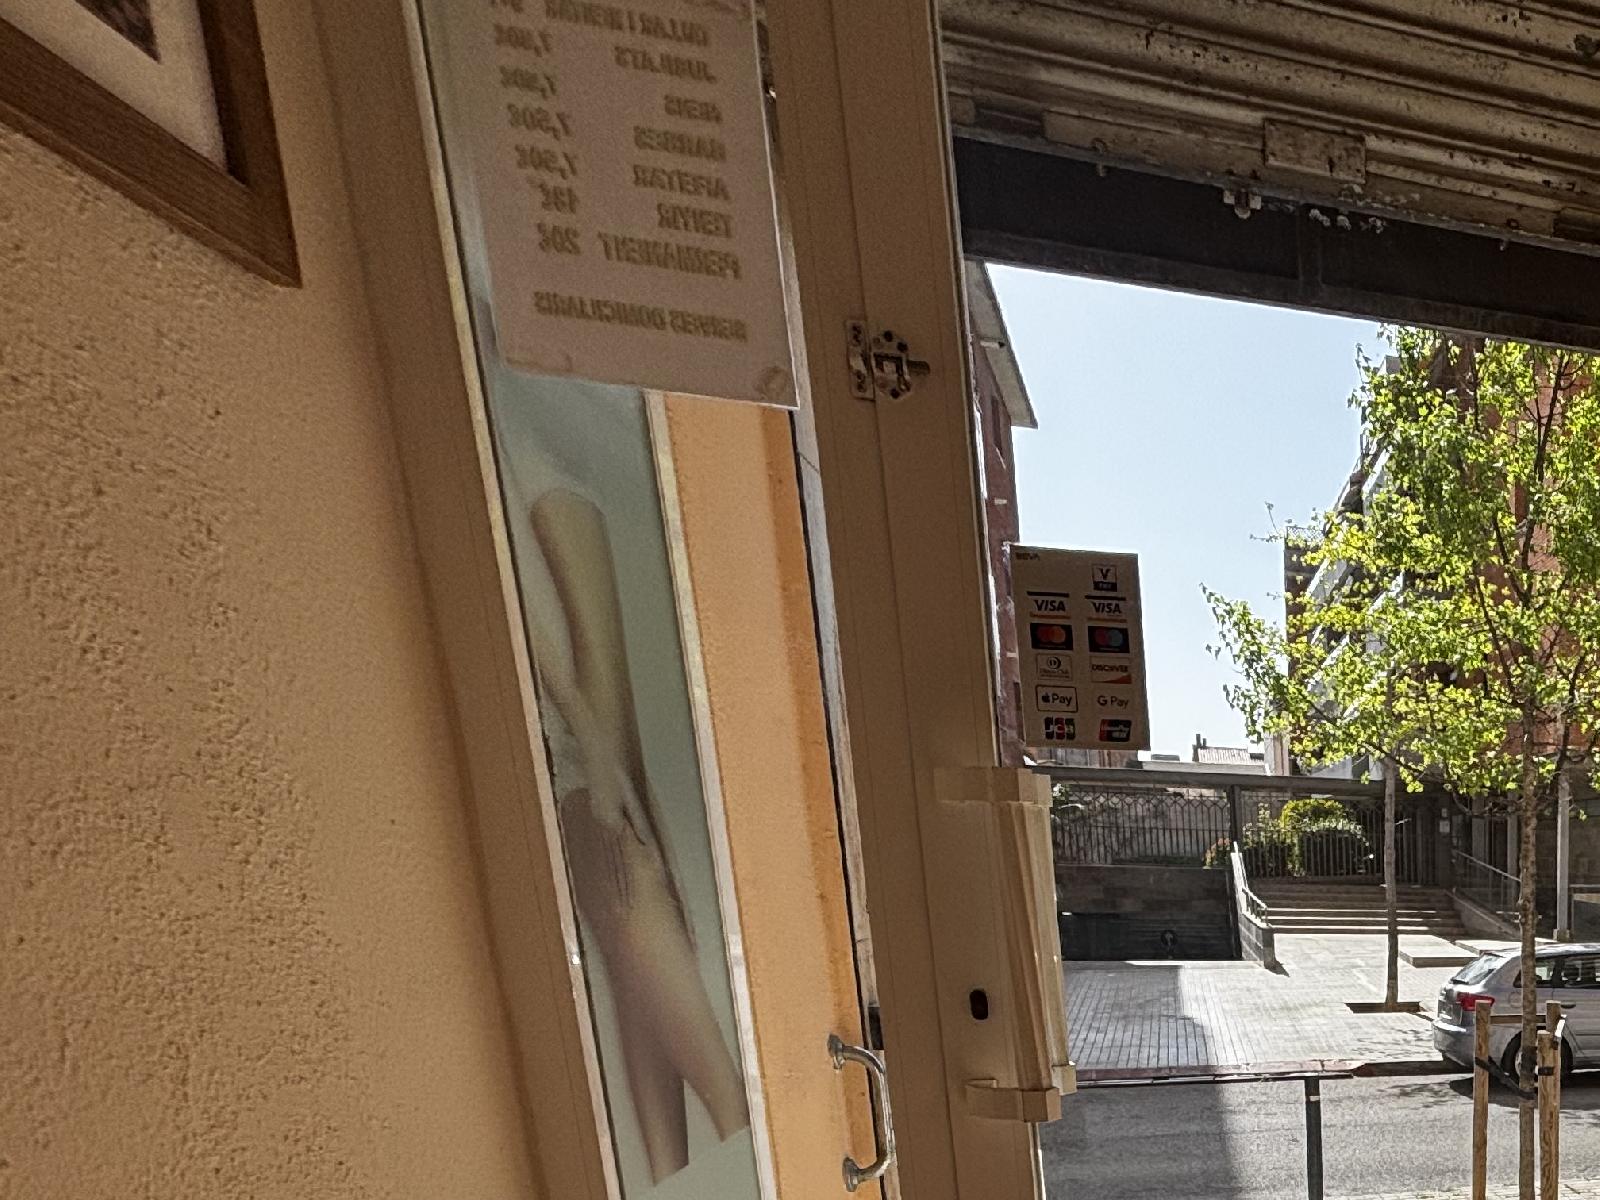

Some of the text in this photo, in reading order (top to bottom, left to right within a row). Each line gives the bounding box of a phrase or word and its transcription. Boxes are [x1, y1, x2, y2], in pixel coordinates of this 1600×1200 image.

[1033, 599, 1067, 612] VISA
[1091, 601, 1122, 615] VISA
[1051, 692, 1073, 707] Pay
[1110, 695, 1129, 709] Pay
